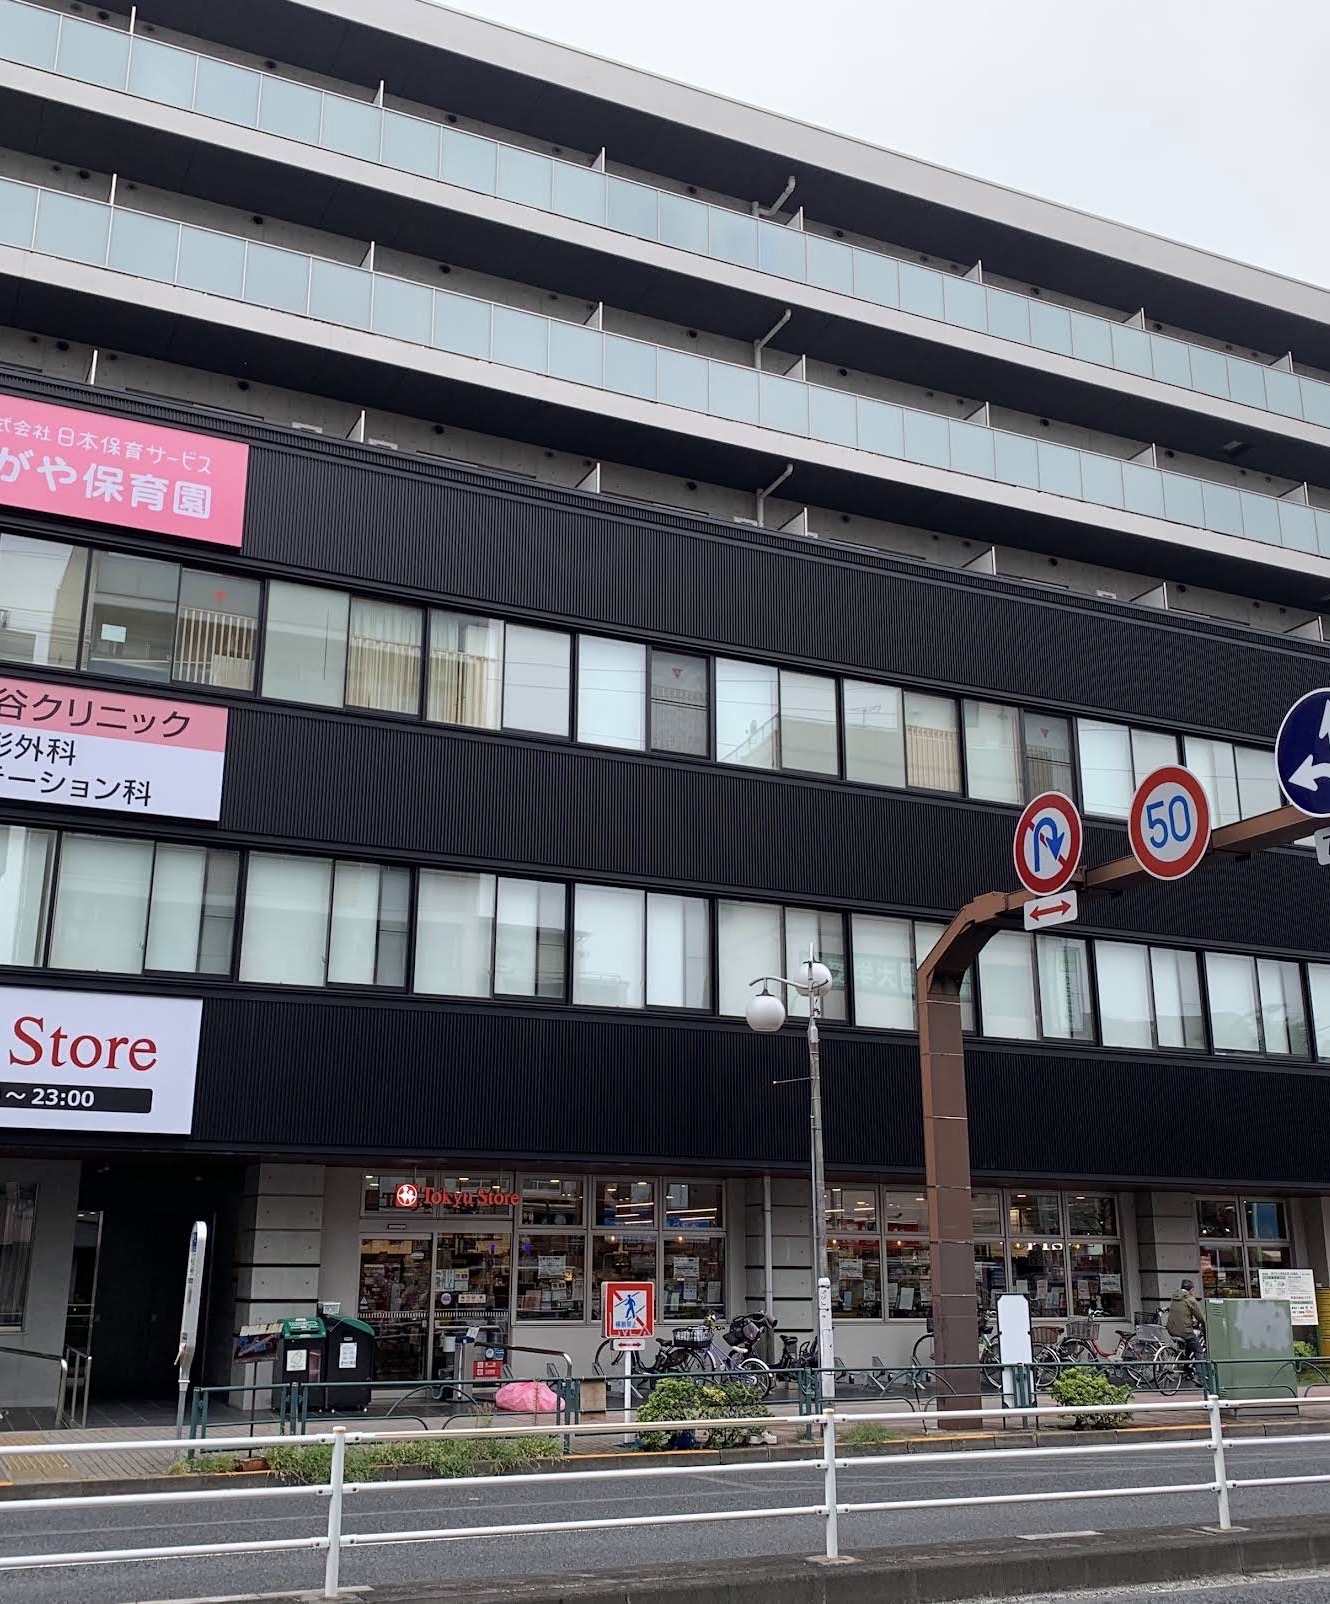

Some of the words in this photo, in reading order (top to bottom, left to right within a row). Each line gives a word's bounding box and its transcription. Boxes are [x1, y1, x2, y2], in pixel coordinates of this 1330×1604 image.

[0, 447, 212, 520] がや保育園
[0, 688, 191, 738] 谷クリニック
[0, 765, 151, 807] ーション科
[1146, 795, 1191, 849] 50
[9, 1016, 157, 1071] Store
[422, 1186, 473, 1208] Tokyu
[477, 1187, 521, 1206] Store
